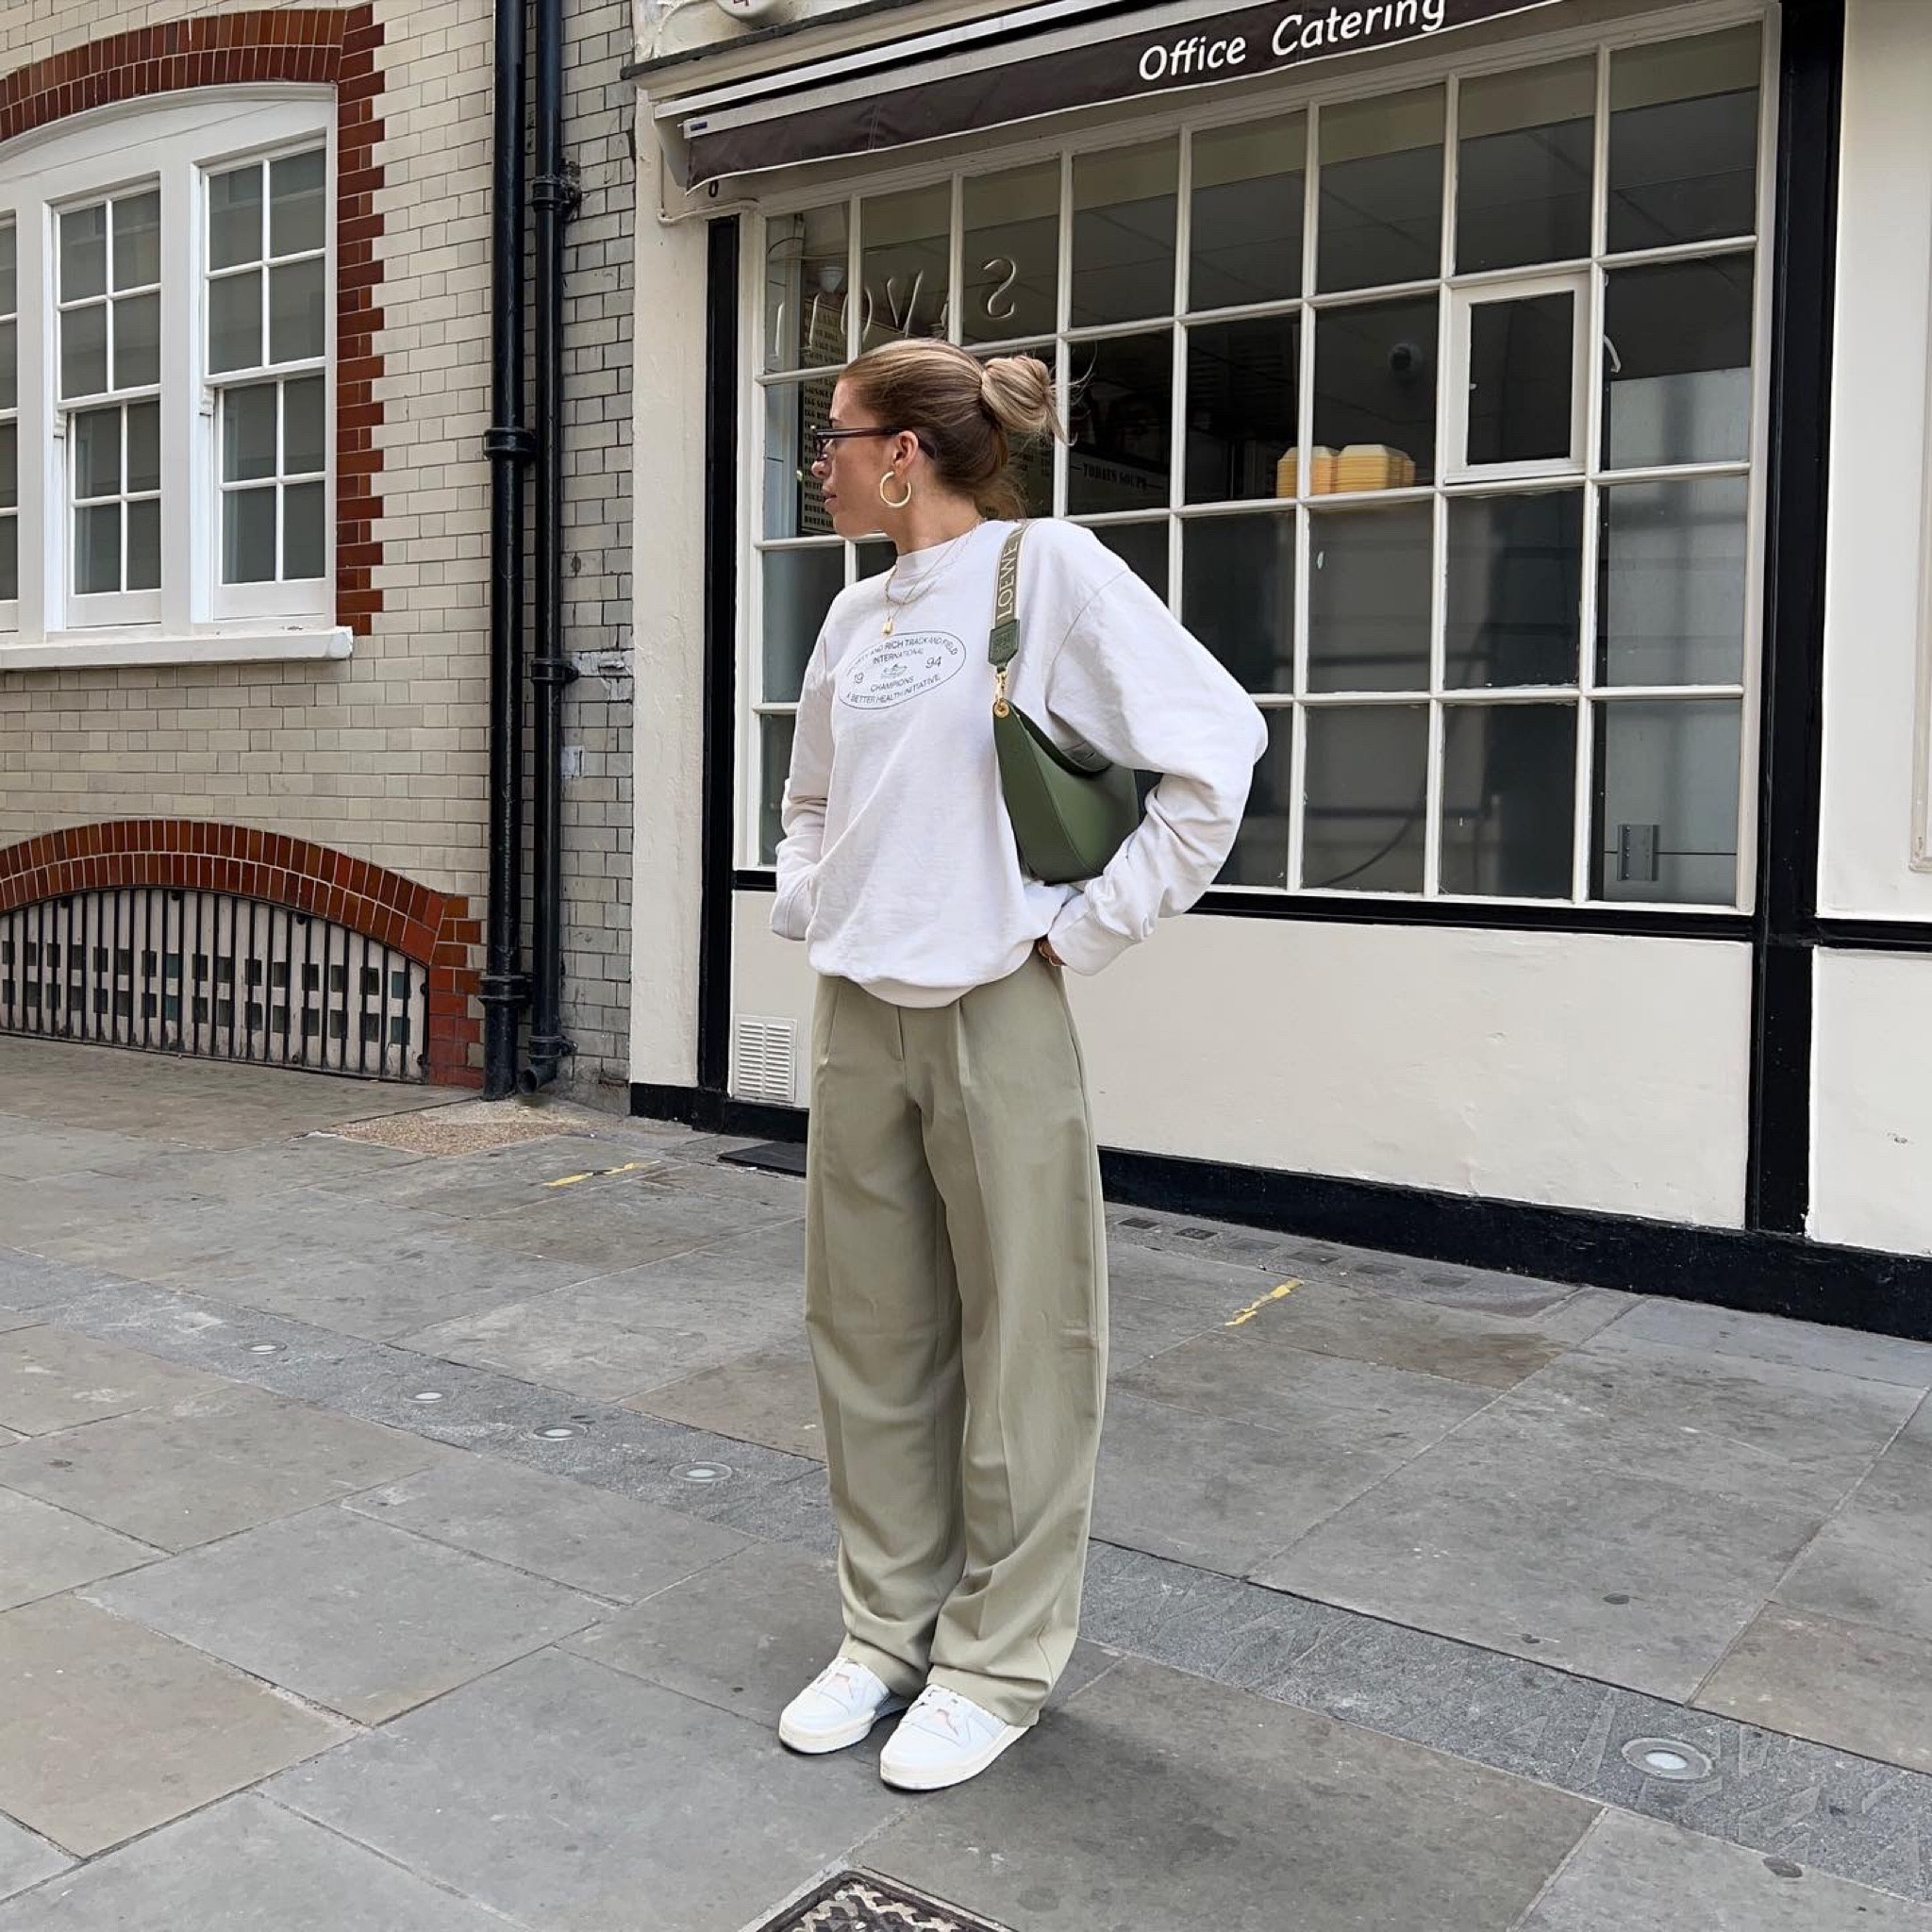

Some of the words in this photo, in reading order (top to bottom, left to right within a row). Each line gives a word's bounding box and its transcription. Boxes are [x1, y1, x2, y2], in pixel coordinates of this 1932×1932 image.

[1139, 36, 1246, 80] Office
[1273, 0, 1444, 56] Catering
[997, 541, 1018, 620] LOEWE
[884, 641, 904, 651] RICH
[905, 636, 928, 647] TRACK
[942, 638, 958, 656] FIELD
[925, 656, 942, 669] 94
[851, 693, 875, 703] BETTER
[875, 691, 903, 703] HEALTH
[903, 674, 941, 695] INITIATIVE
[870, 675, 914, 692] CHAMPIONS
